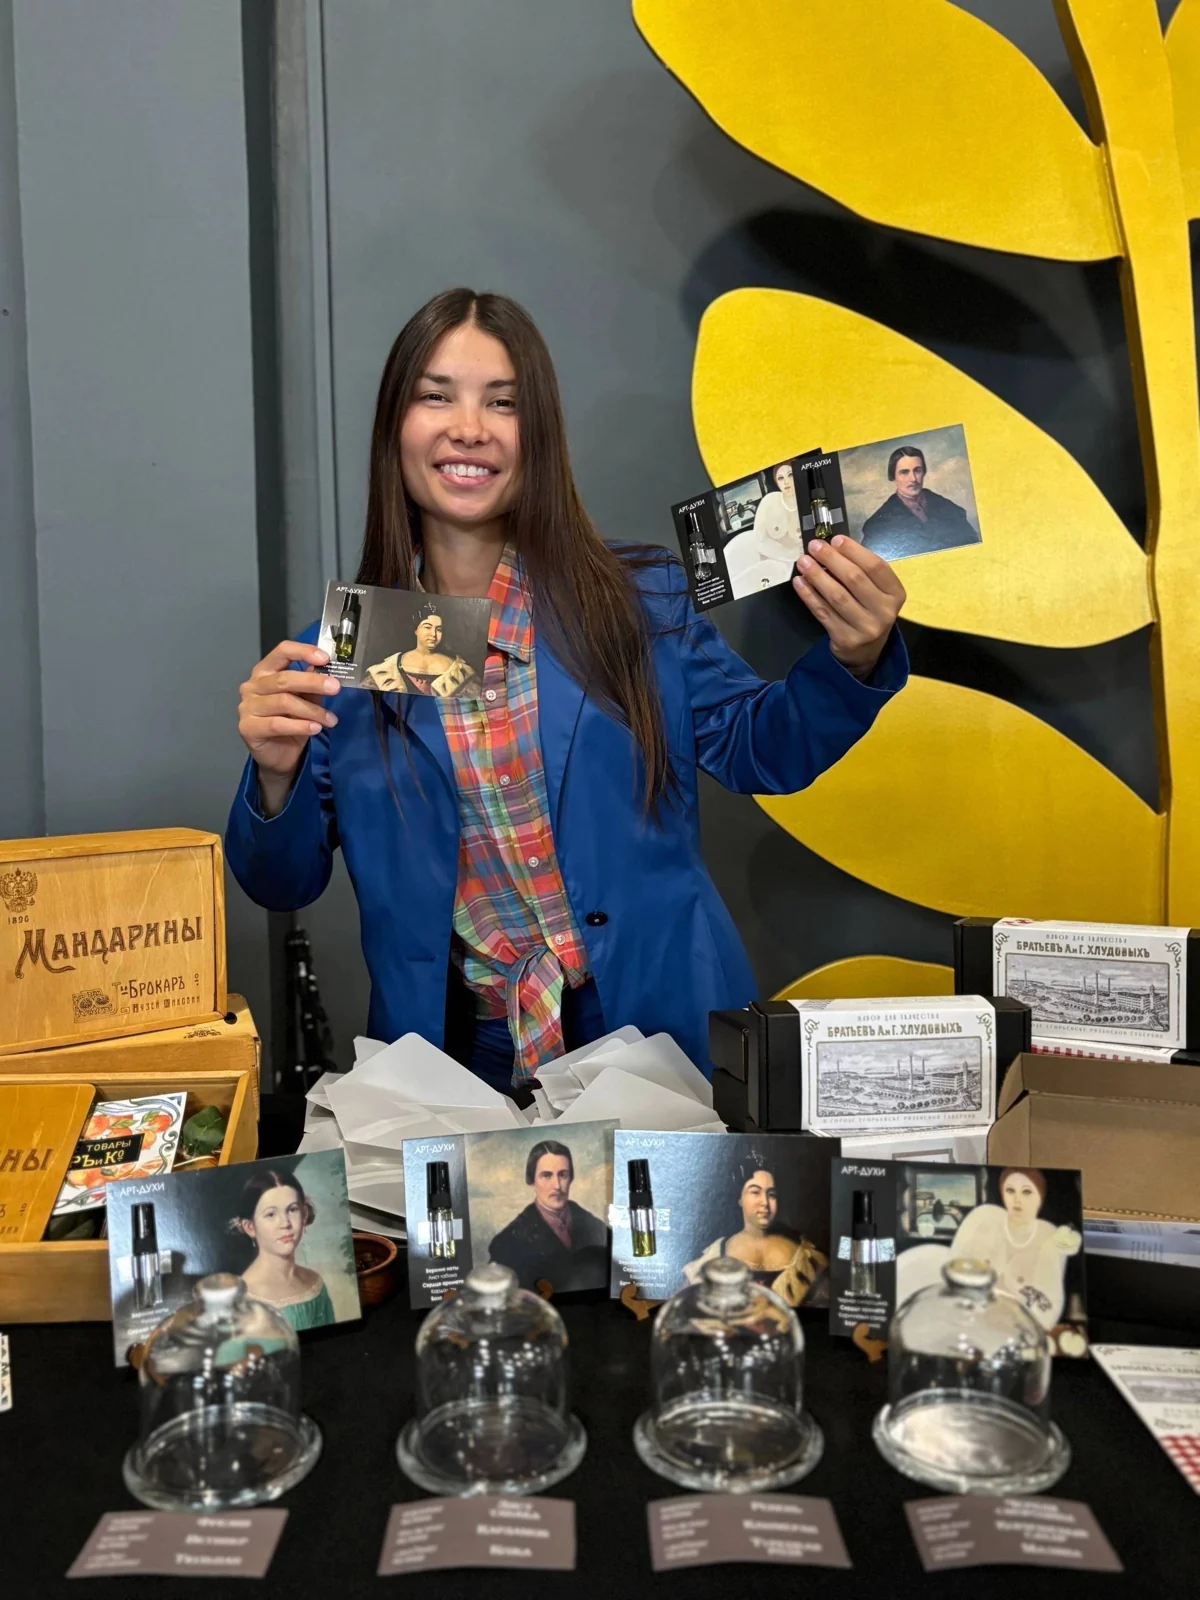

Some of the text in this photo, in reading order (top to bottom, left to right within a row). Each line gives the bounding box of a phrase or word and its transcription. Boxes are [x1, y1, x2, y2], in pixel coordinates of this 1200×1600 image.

[801, 458, 832, 470] АРТ-ДУХИ
[678, 499, 705, 514] АРТ-ДУХИ
[336, 586, 367, 594] АРТ-ДУХИ
[1016, 941, 1062, 953] БРАТЬЕВЪ
[1087, 945, 1150, 958] ХЛУДОВЫХЪ
[827, 1025, 875, 1038] БРАТЬЕВЪ
[900, 1022, 963, 1035] ХЛУДОВЫХЪ
[86, 1140, 132, 1152] ТОВАРЫ
[625, 1138, 665, 1147] АРТ-ДУХИ
[415, 1143, 455, 1155] АРТ-ДУХИ
[841, 1166, 886, 1177] АРТ-ДУХИ
[120, 1182, 165, 1198] АРТ-ДУХИ
